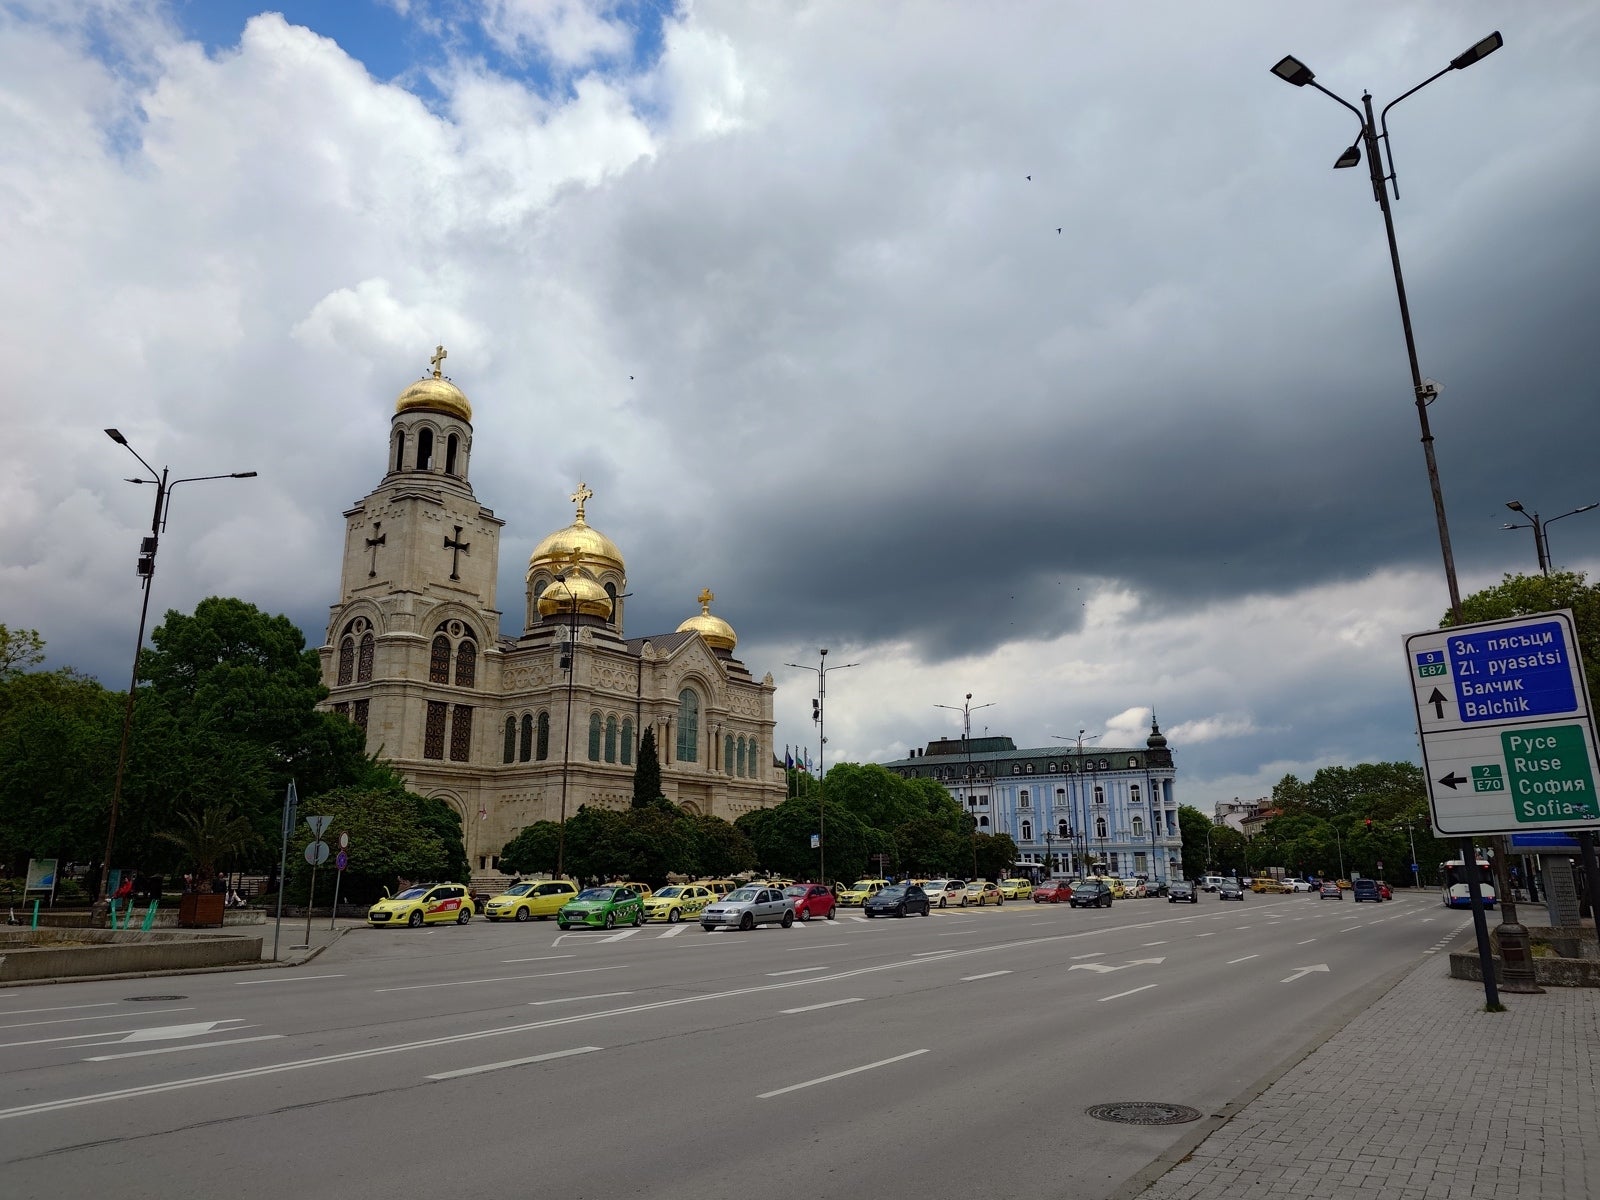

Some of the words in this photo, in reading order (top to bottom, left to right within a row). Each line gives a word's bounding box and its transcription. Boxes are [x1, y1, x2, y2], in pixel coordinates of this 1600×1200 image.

[1455, 640, 1480, 656] Зл.
[1488, 631, 1553, 652] пясъци
[1426, 653, 1434, 663] 9
[1459, 660, 1480, 676] Zl.
[1489, 650, 1562, 676] pyasatsi
[1421, 664, 1444, 677] E87
[1461, 677, 1525, 696] Балчик
[1465, 697, 1531, 717] Balchik
[1509, 735, 1557, 754] Русе
[1482, 767, 1491, 777] 2
[1514, 757, 1562, 773] Ruse
[1477, 779, 1501, 791] E70
[1518, 778, 1586, 795] София
[1523, 800, 1573, 817] Sofia
